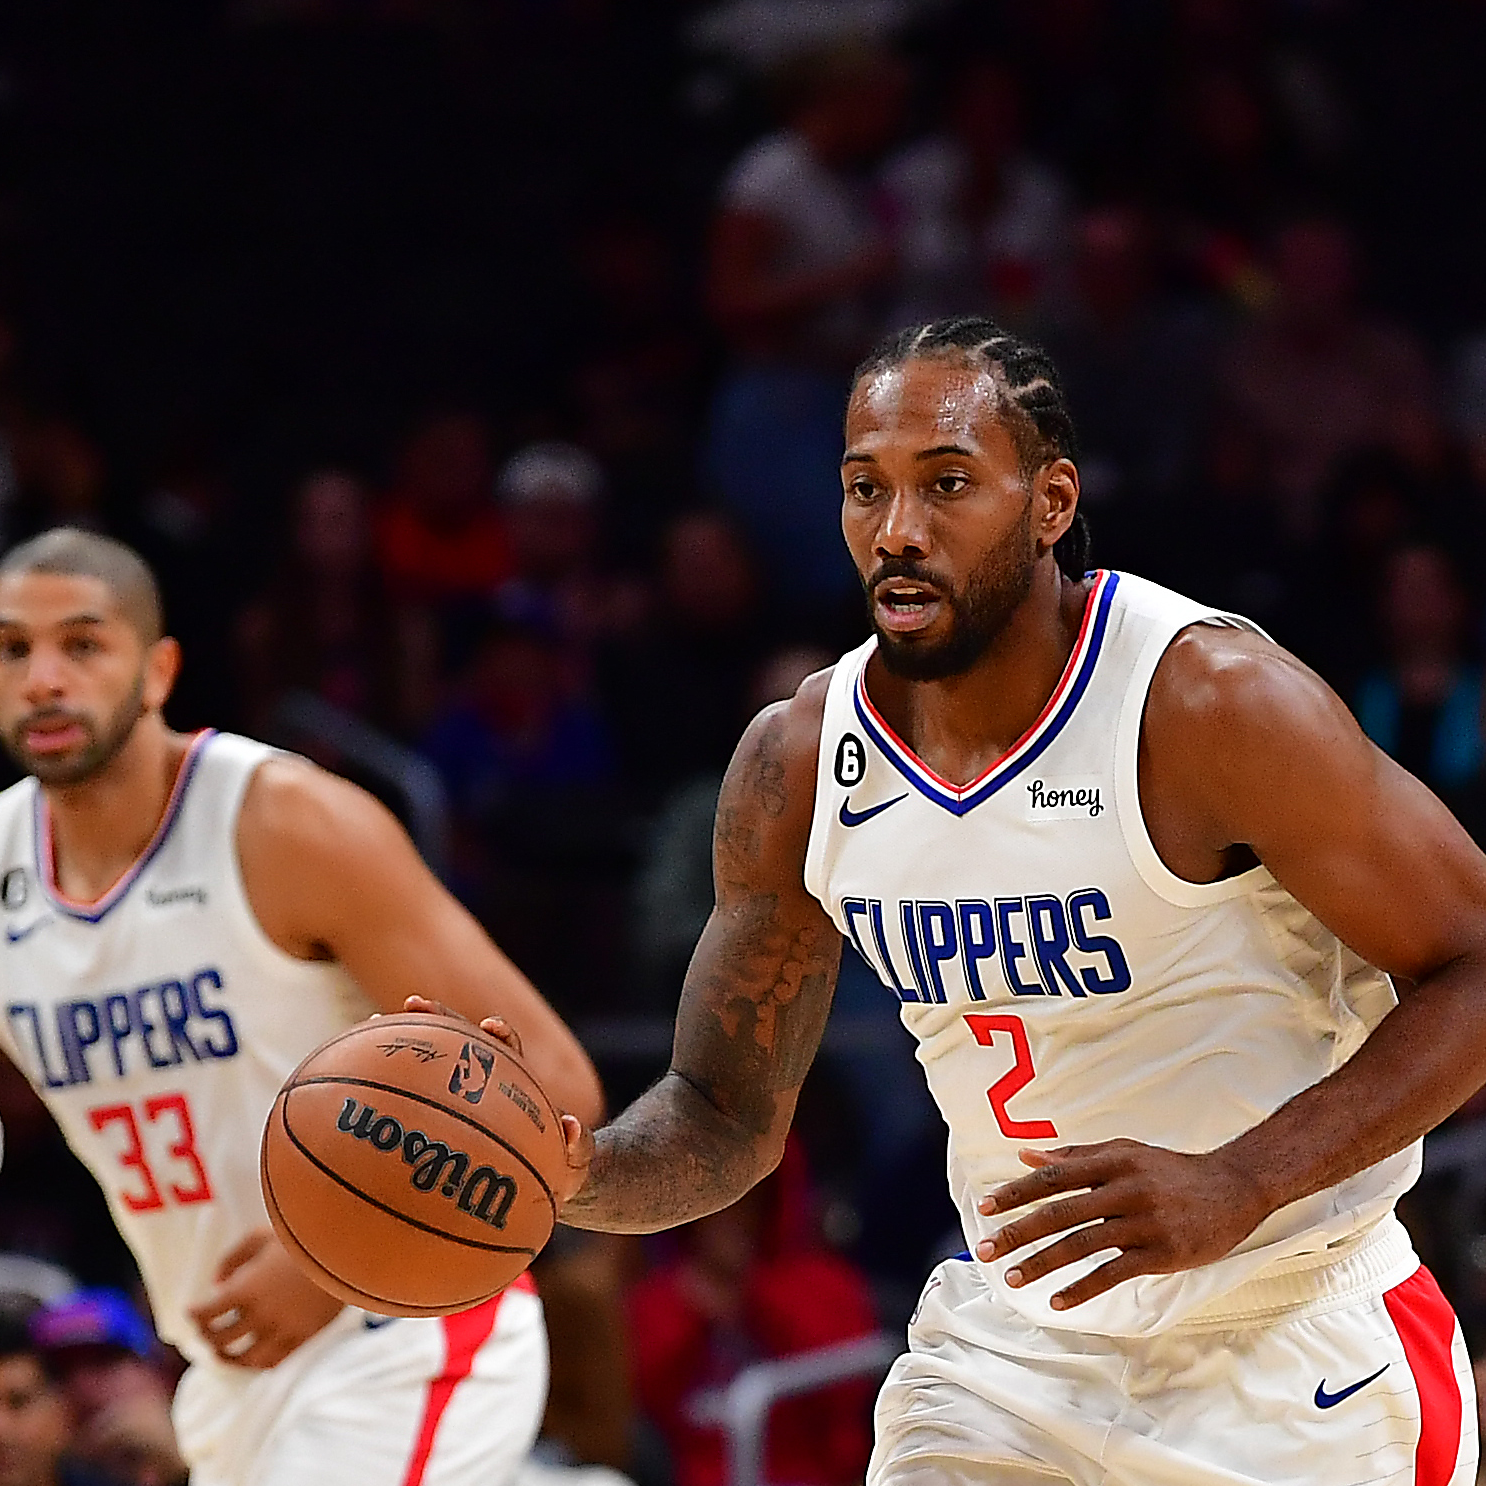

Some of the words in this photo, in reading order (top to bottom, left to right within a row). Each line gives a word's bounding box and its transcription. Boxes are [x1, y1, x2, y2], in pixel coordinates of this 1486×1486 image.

[1027, 779, 1104, 817] honey
[841, 887, 1133, 1004] CLIPPERS
[962, 1014, 1059, 1140] 2
[87, 1091, 215, 1213] 33
[336, 1097, 519, 1231] Wilson
